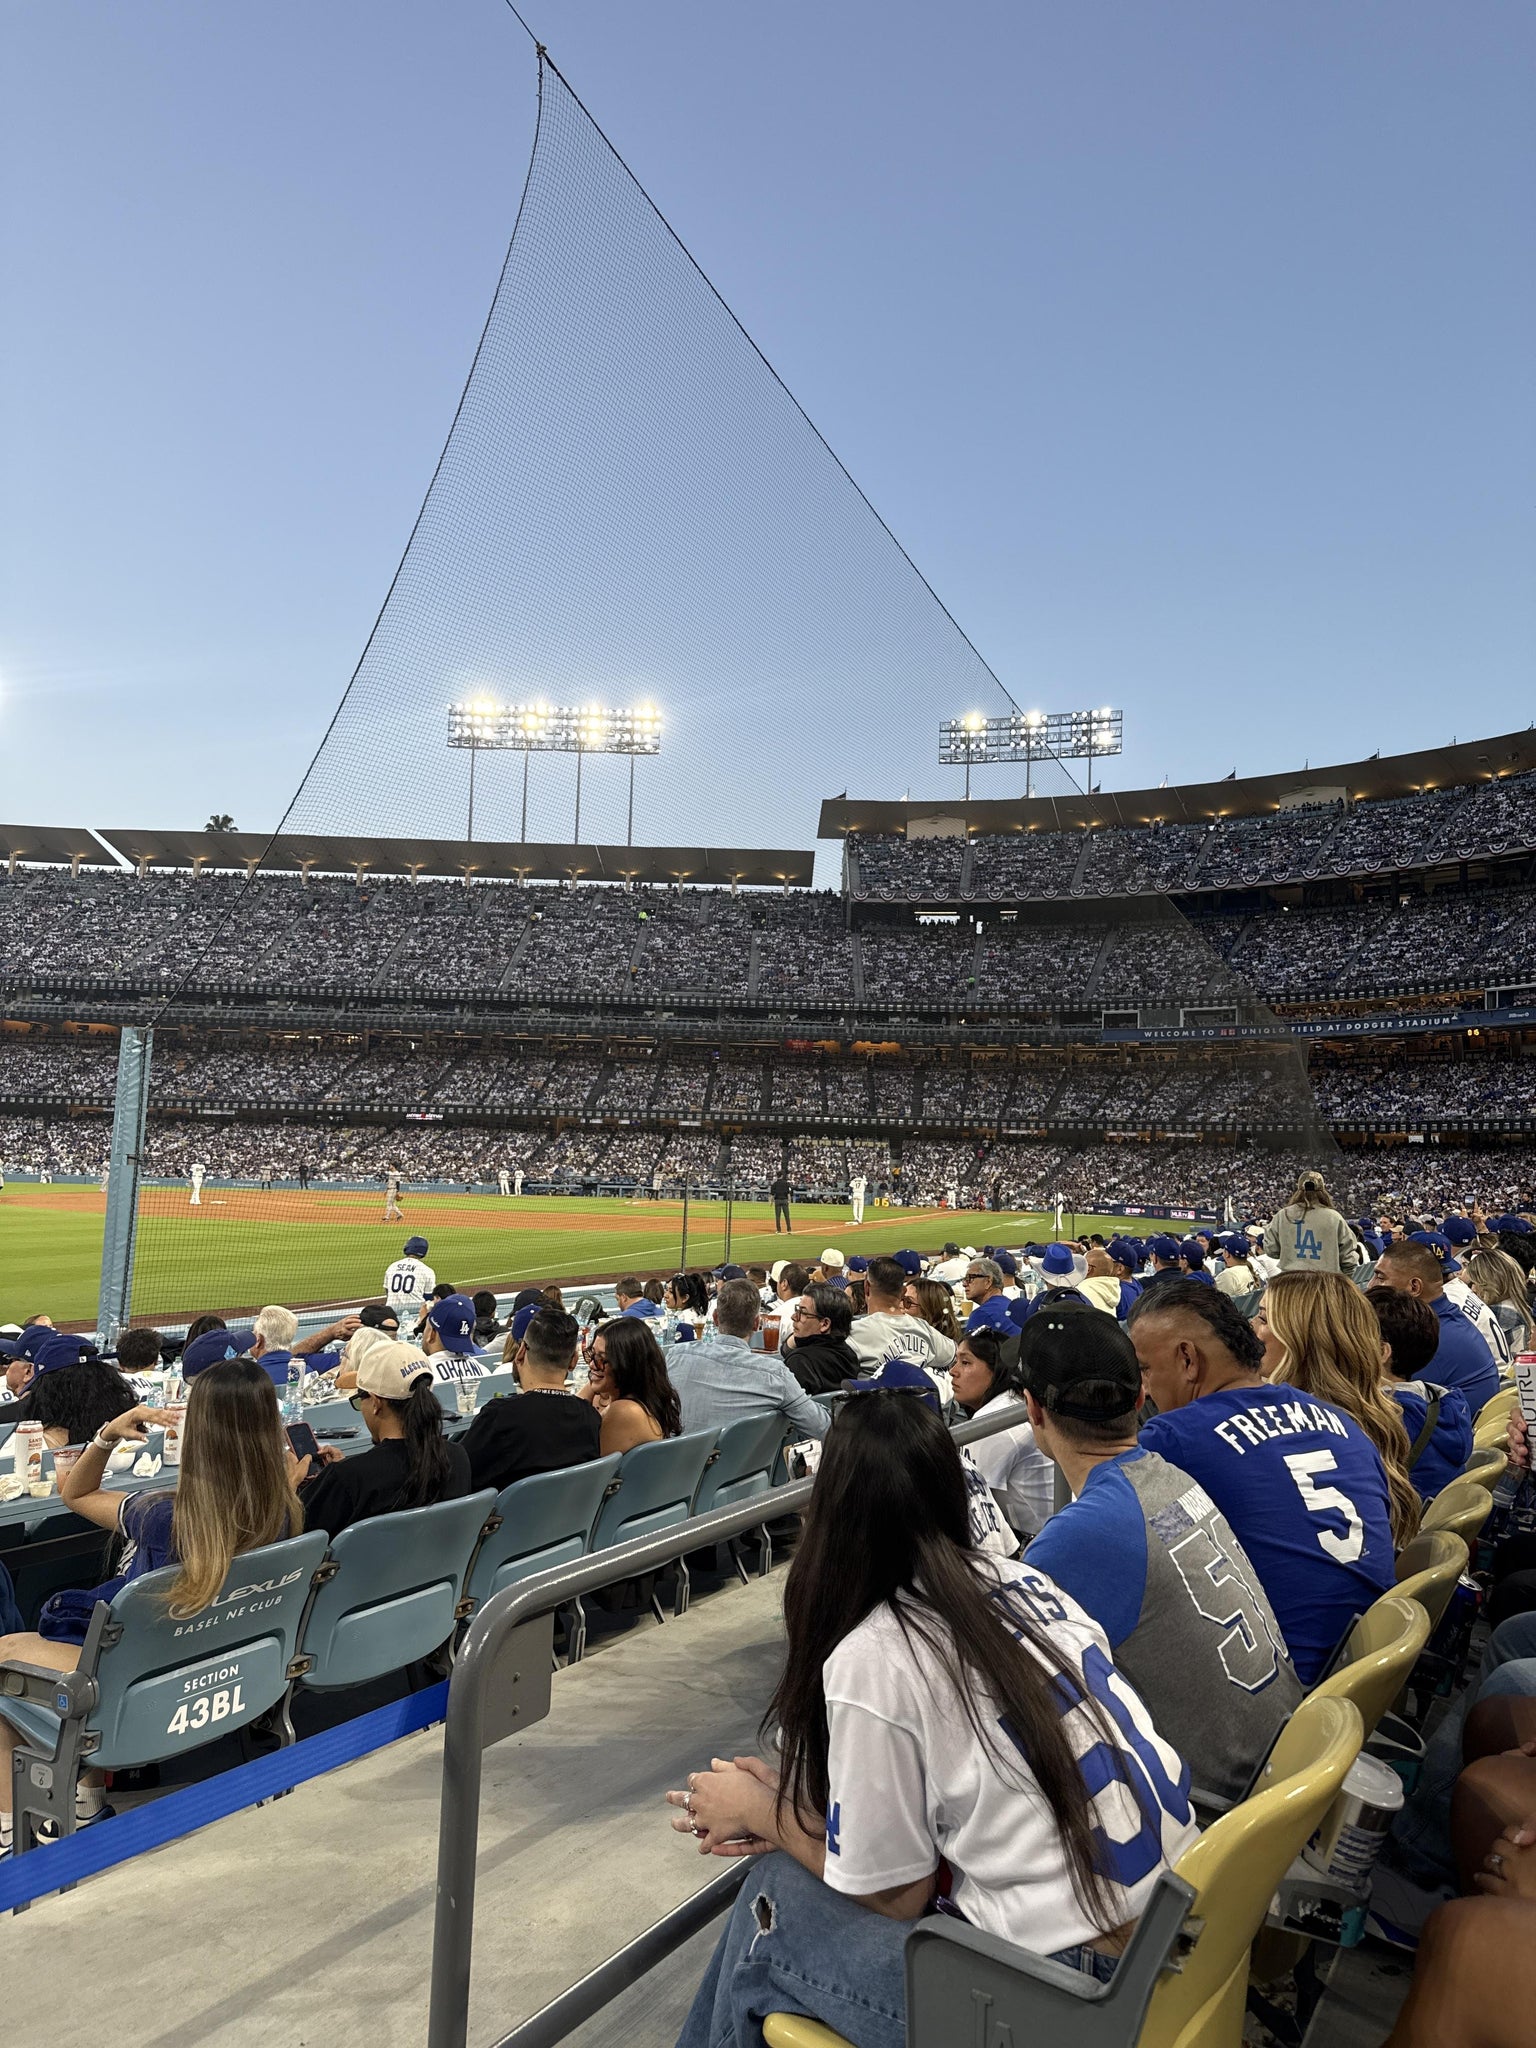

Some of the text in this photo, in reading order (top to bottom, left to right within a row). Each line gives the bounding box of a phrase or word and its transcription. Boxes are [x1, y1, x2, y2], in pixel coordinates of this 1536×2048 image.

[1144, 1029, 1196, 1038] WELCOME
[1241, 1026, 1286, 1036] UNIQLO
[1291, 1025, 1322, 1033] FIELD
[1328, 1023, 1341, 1031] AT
[1346, 1021, 1393, 1030] DODGER
[1398, 1018, 1450, 1027] STADIUM
[1294, 1219, 1322, 1260] LA
[1431, 1243, 1445, 1259] LA
[396, 1263, 416, 1273] SEAN
[391, 1273, 416, 1294] 00
[459, 1320, 470, 1335] LA
[436, 1358, 483, 1381] OHTANI
[1214, 1401, 1349, 1455] FREEMAN
[1283, 1449, 1364, 1564] 5
[211, 1567, 304, 1608] LEXUS
[250, 1595, 283, 1613] CLUB
[184, 1664, 240, 1693] SECTION
[166, 1684, 246, 1736] 43BL
